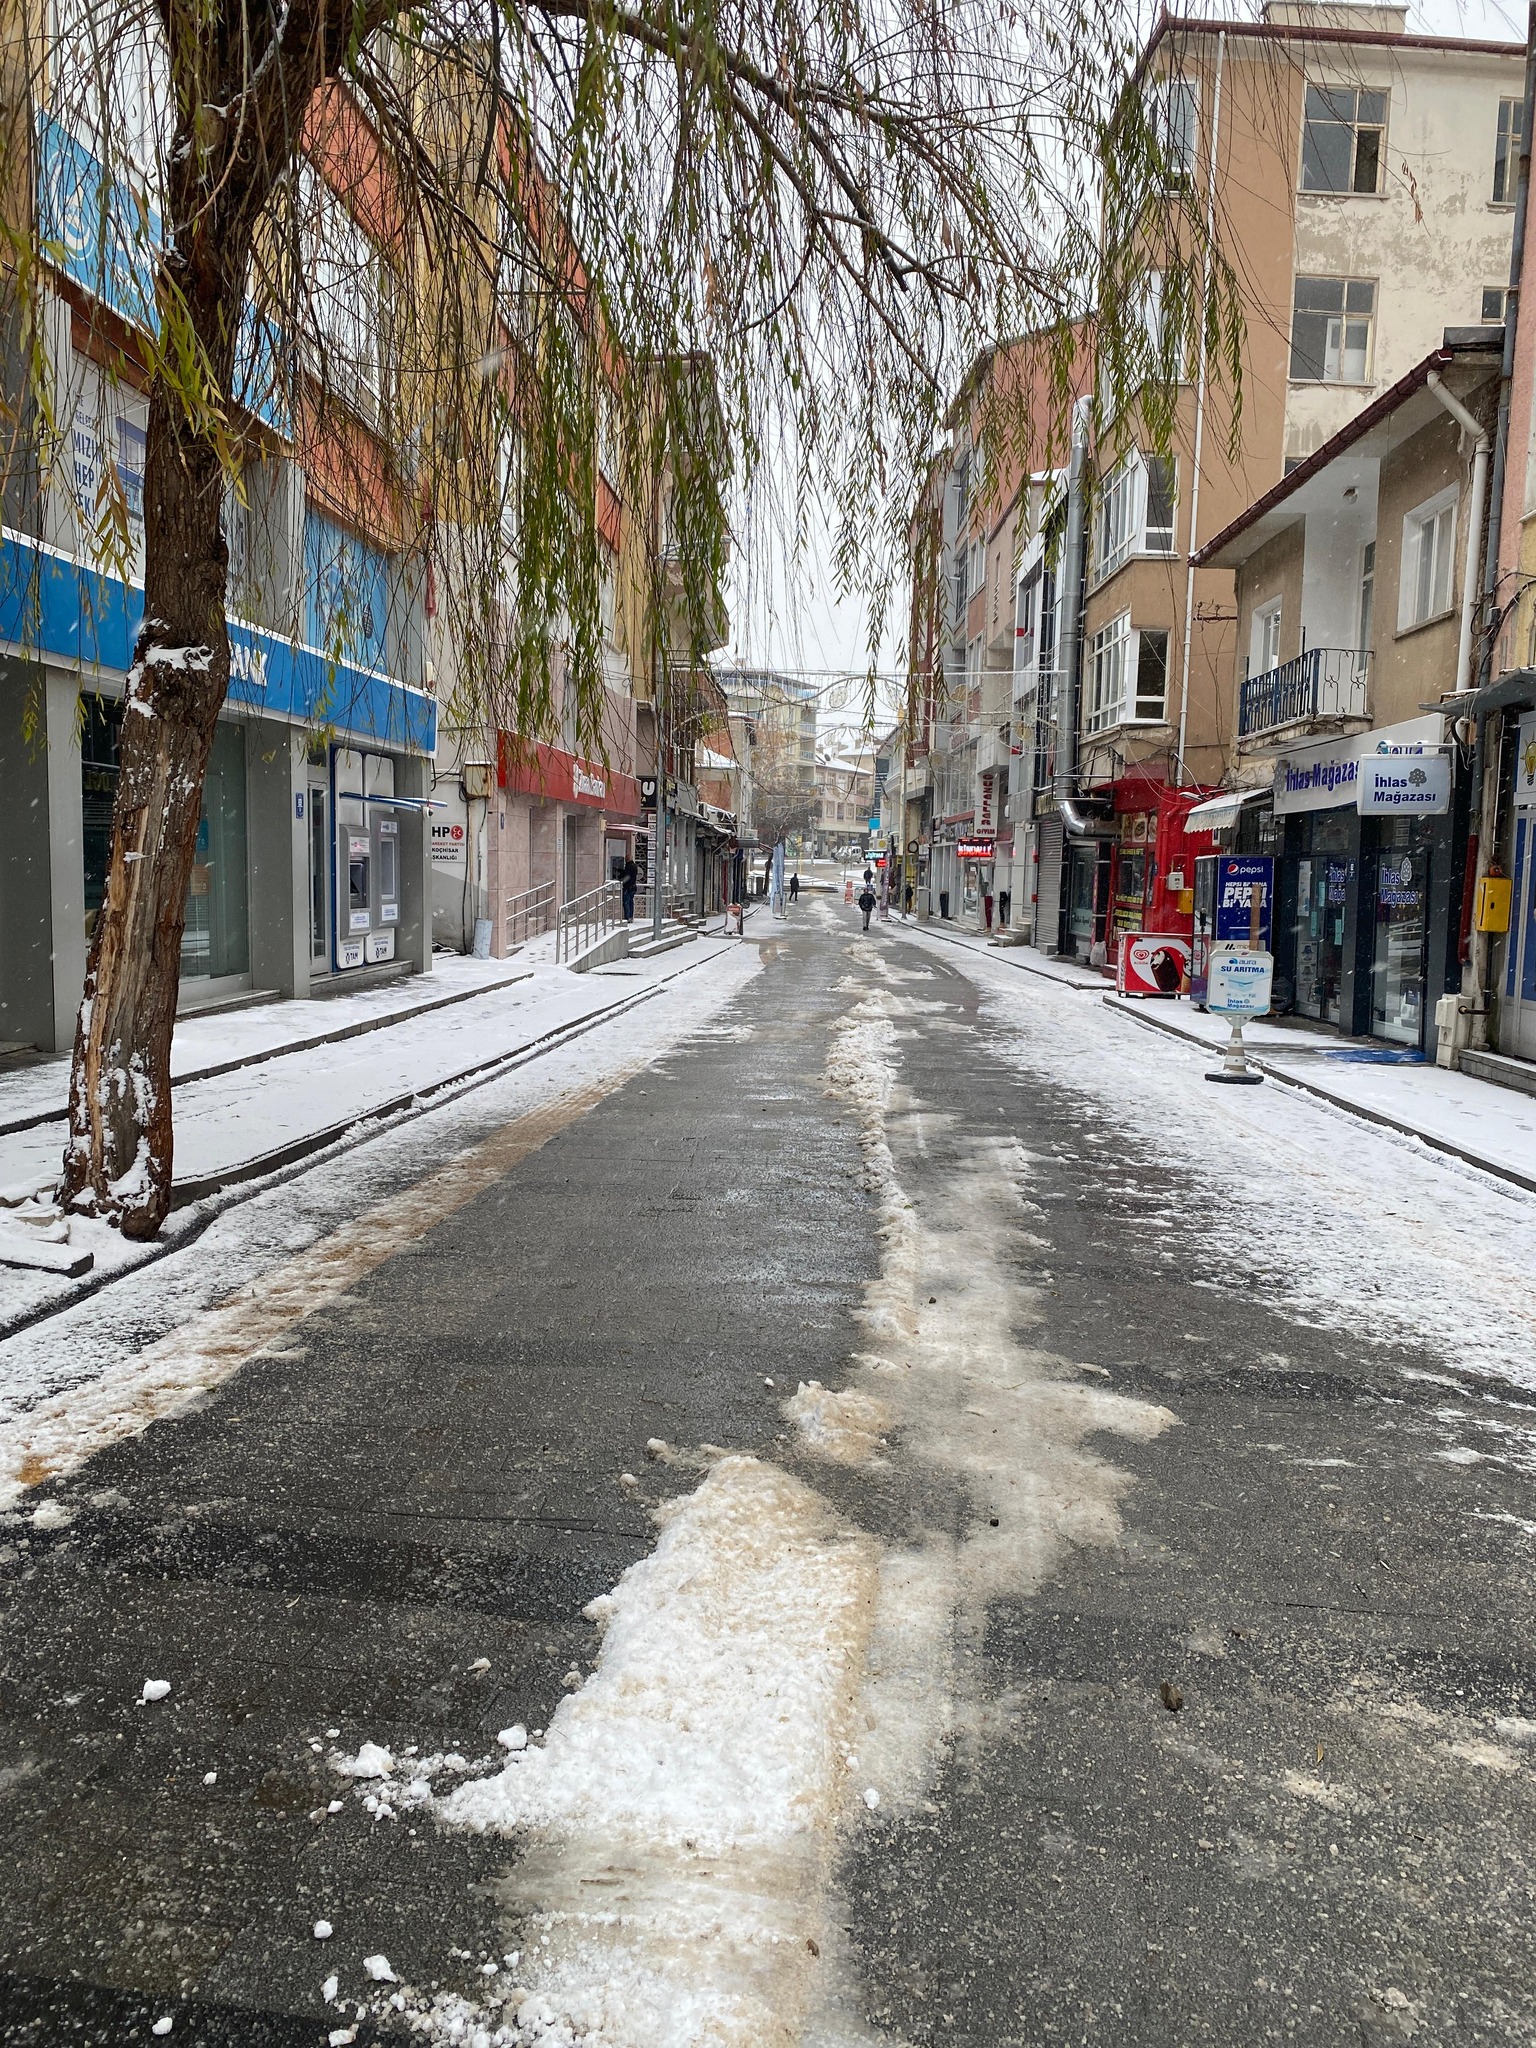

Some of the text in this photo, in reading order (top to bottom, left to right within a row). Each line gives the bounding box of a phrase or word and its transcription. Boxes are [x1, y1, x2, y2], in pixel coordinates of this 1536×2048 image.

[1374, 773, 1408, 788] İhlas
[1373, 790, 1437, 804] Mağazası
[1239, 866, 1264, 875] pepsi
[1224, 887, 1268, 899] PEPI
[1239, 899, 1268, 908] YAA
